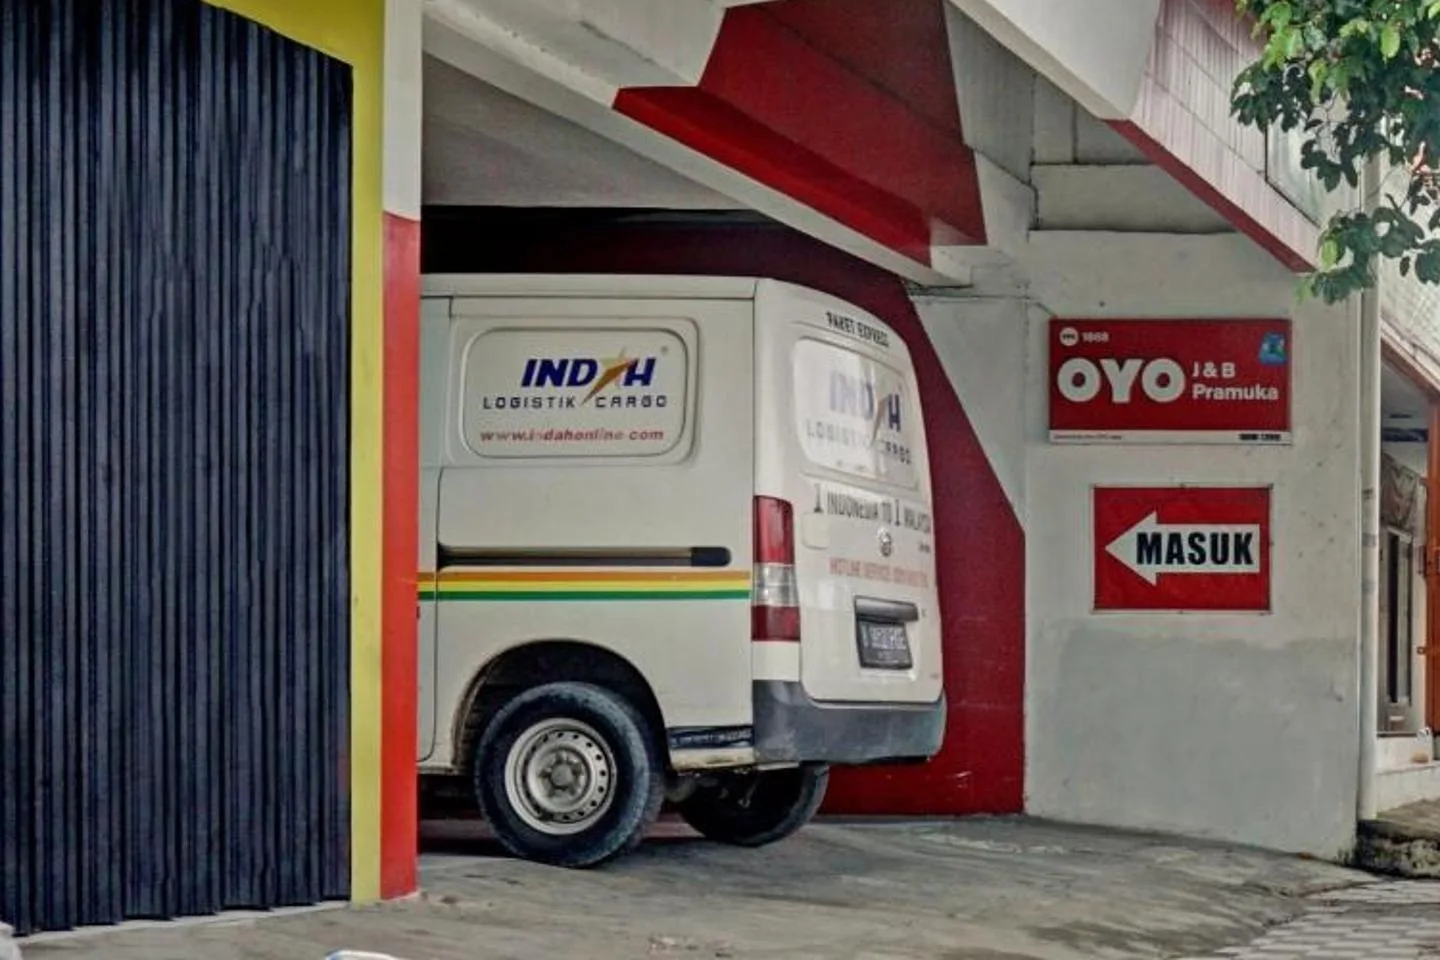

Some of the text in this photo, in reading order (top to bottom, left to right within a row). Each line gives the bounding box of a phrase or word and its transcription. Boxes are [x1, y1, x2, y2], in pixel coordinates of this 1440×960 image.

[1191, 361, 1236, 379] J & B
[1057, 357, 1186, 403] OYO
[1191, 382, 1279, 401] Pramuka
[482, 394, 668, 411] LOGISTIK CARGO
[1135, 531, 1254, 566] MASUK
